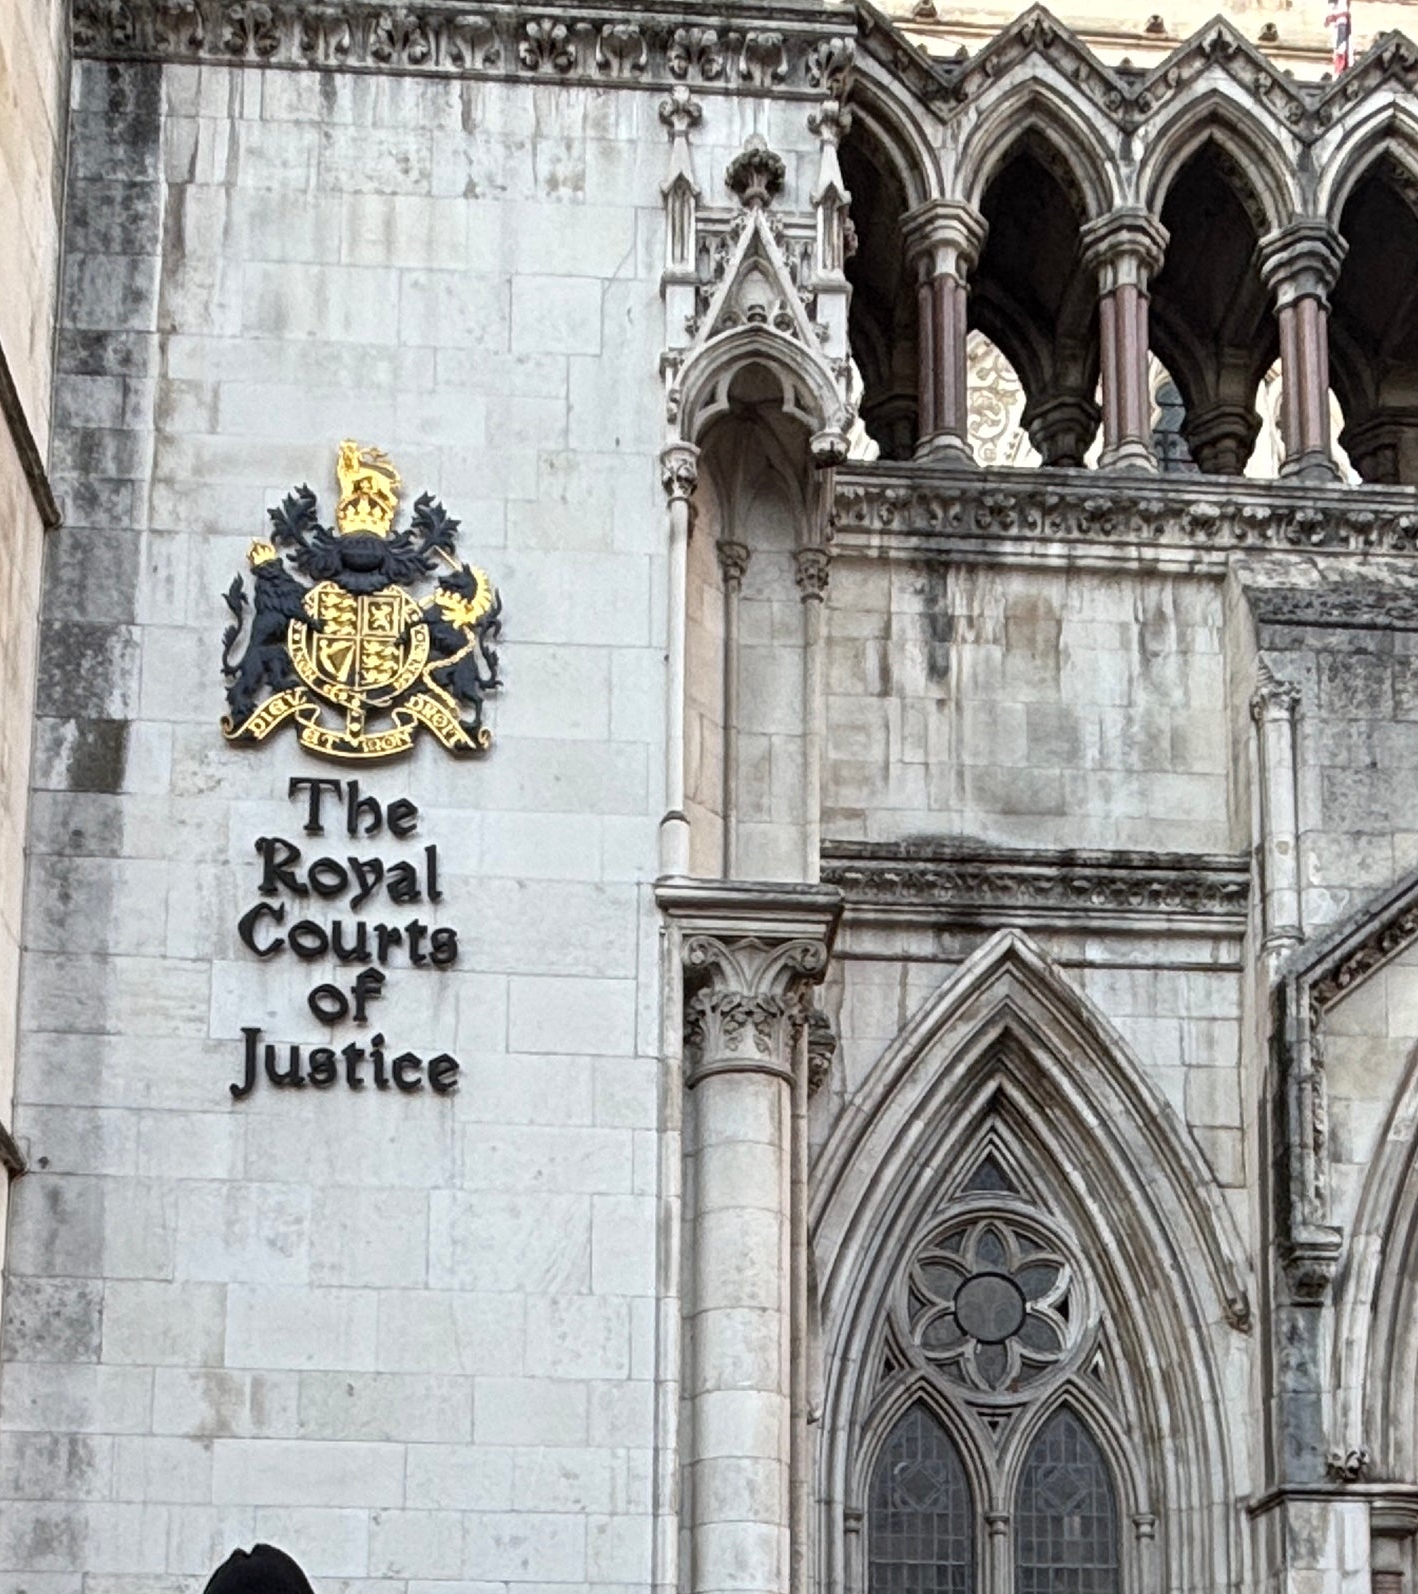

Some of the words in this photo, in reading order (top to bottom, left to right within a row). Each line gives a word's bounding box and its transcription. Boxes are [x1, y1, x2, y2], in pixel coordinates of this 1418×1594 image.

[288, 776, 419, 836] The
[254, 837, 443, 910] Royal
[238, 902, 460, 968] Courts
[307, 967, 386, 1024] of
[229, 1027, 461, 1098] Justice
